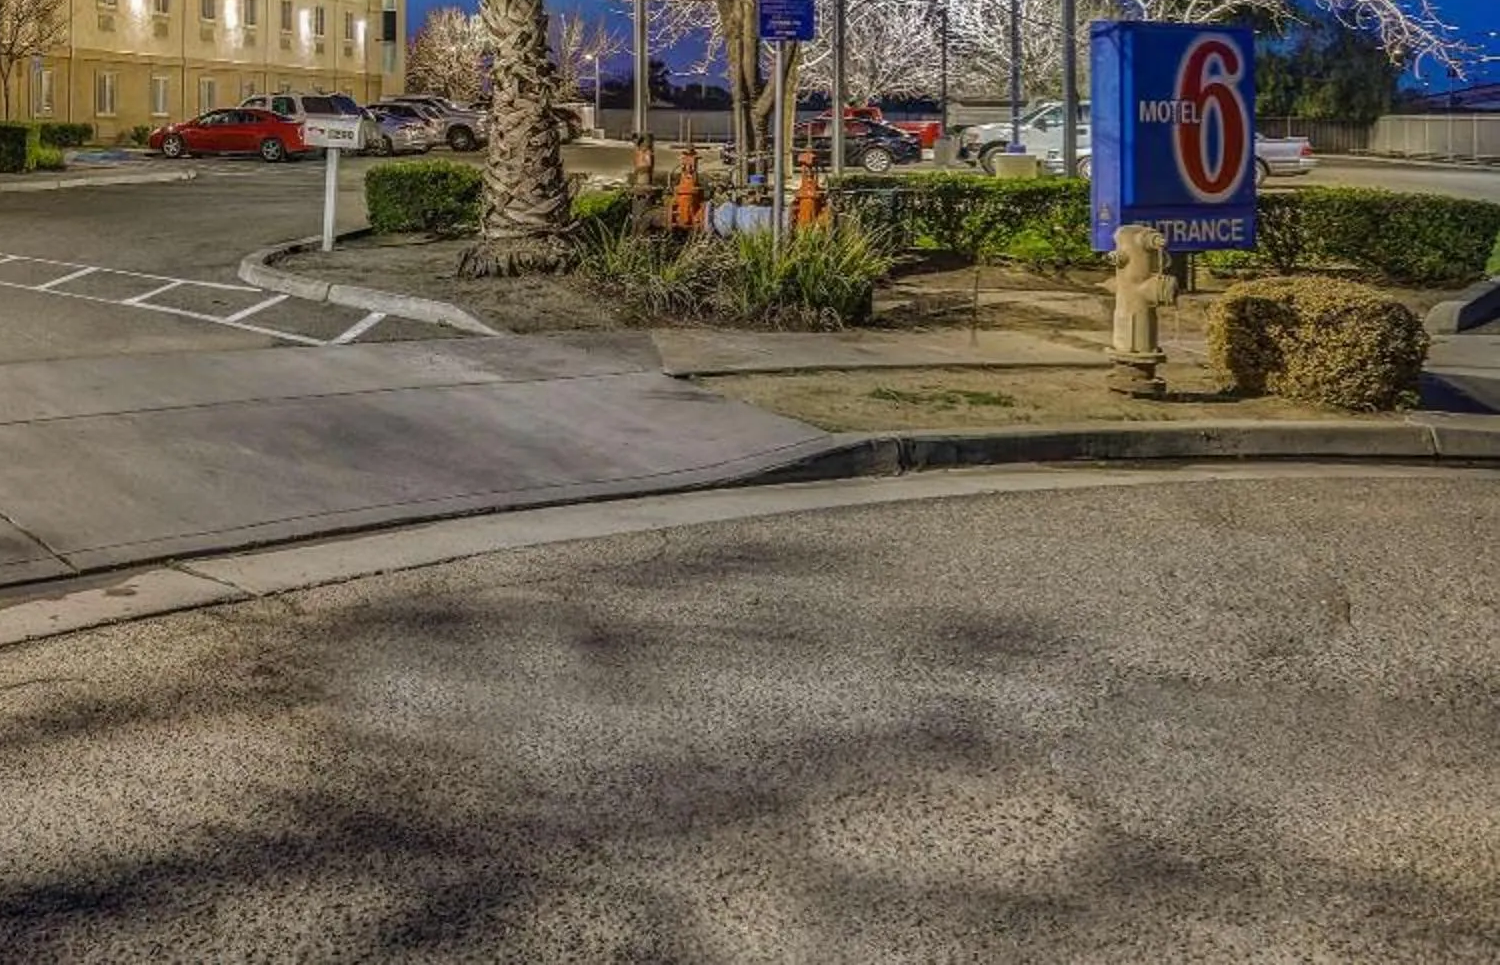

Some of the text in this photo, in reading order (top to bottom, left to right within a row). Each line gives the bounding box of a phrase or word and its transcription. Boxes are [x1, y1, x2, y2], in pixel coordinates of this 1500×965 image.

[1139, 33, 1248, 203] MOTEL 6
[1132, 218, 1245, 242] TRANCE
